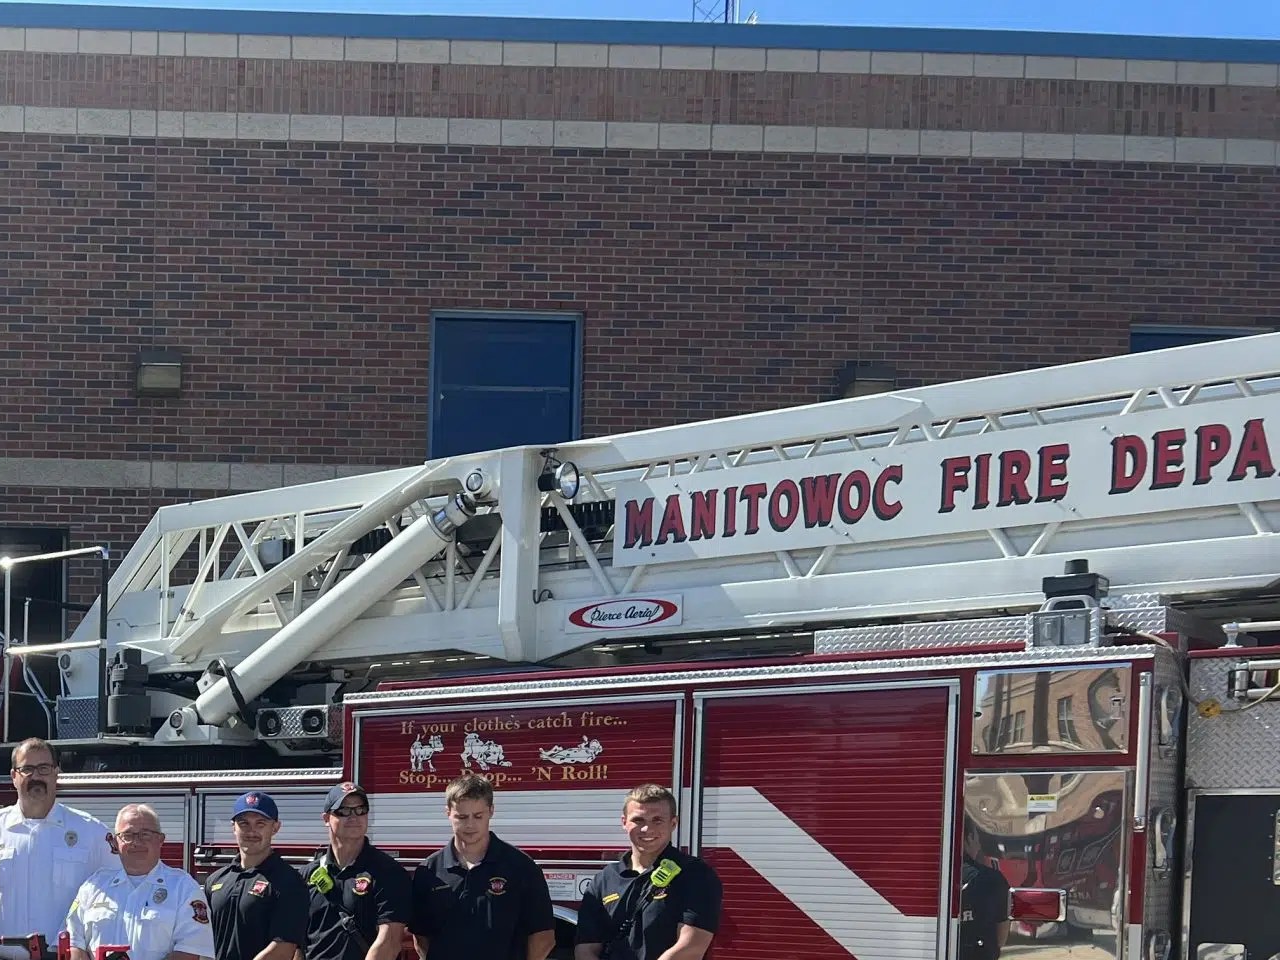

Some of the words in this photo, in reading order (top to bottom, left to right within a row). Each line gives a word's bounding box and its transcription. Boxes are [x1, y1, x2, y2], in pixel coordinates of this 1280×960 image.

[622, 464, 903, 549] MANITOWOC
[938, 443, 1071, 513] FIRE
[1108, 418, 1280, 495] DEPA
[400, 721, 414, 735] If
[421, 722, 456, 739] your
[464, 717, 521, 732] clothes
[528, 712, 572, 730] catch
[581, 711, 628, 728] fire...
[399, 771, 451, 788] Stop...
[562, 764, 609, 781] Roll!
